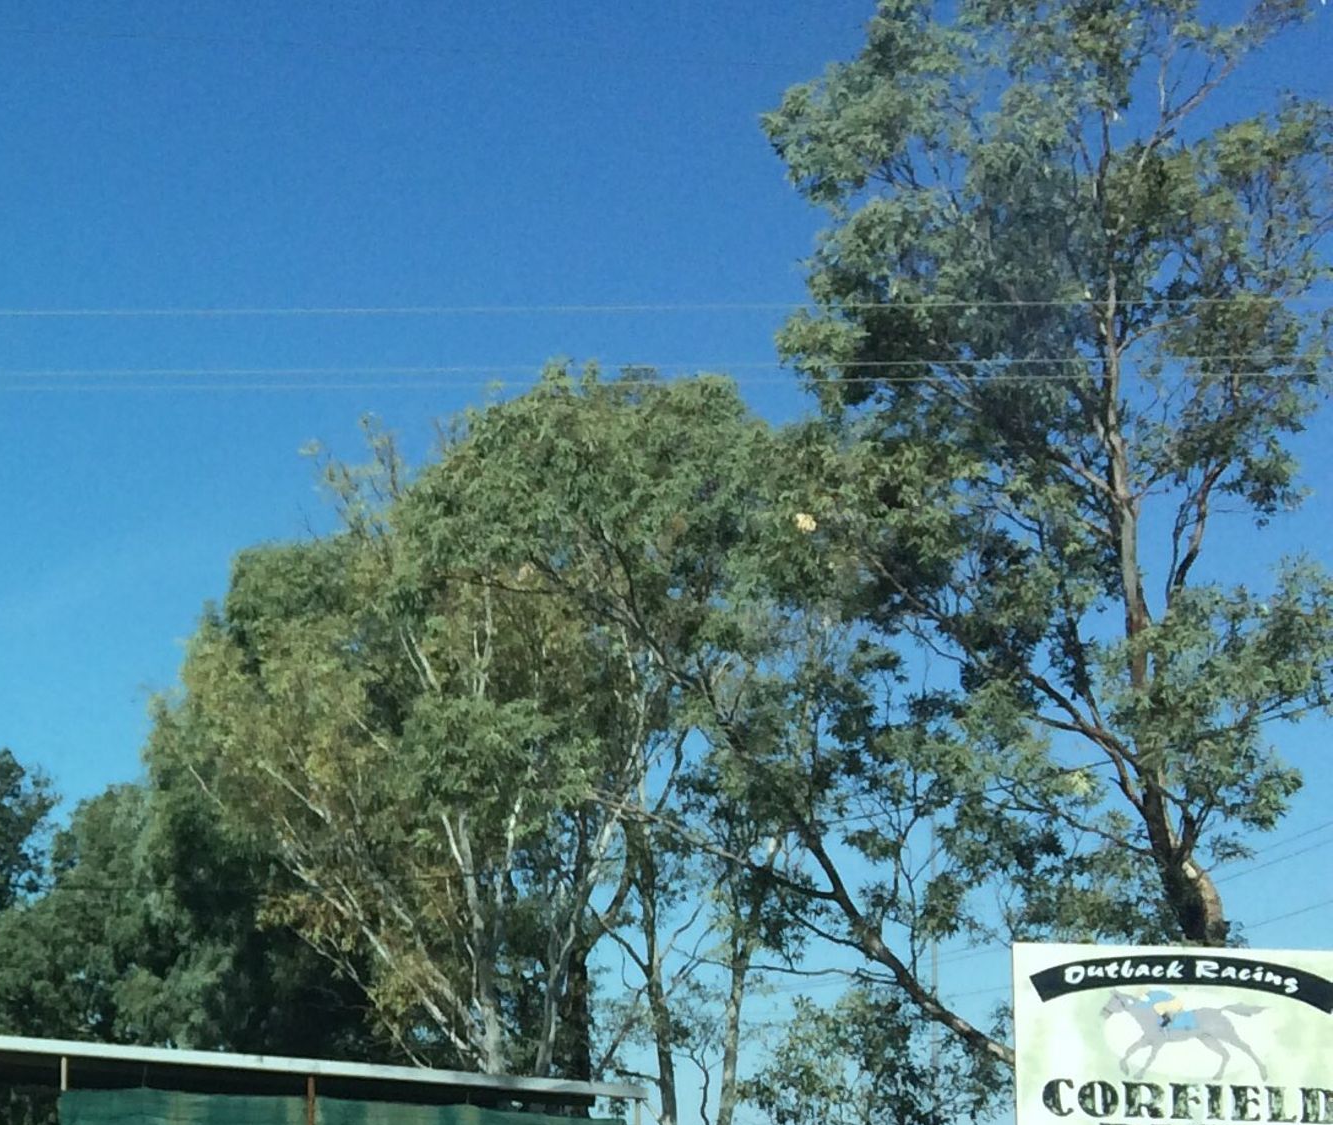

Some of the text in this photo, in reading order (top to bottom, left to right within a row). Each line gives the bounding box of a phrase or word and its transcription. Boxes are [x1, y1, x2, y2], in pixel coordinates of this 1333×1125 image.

[1064, 959, 1301, 994] Outback Racing
[1042, 1078, 1333, 1125] CORFIELD
